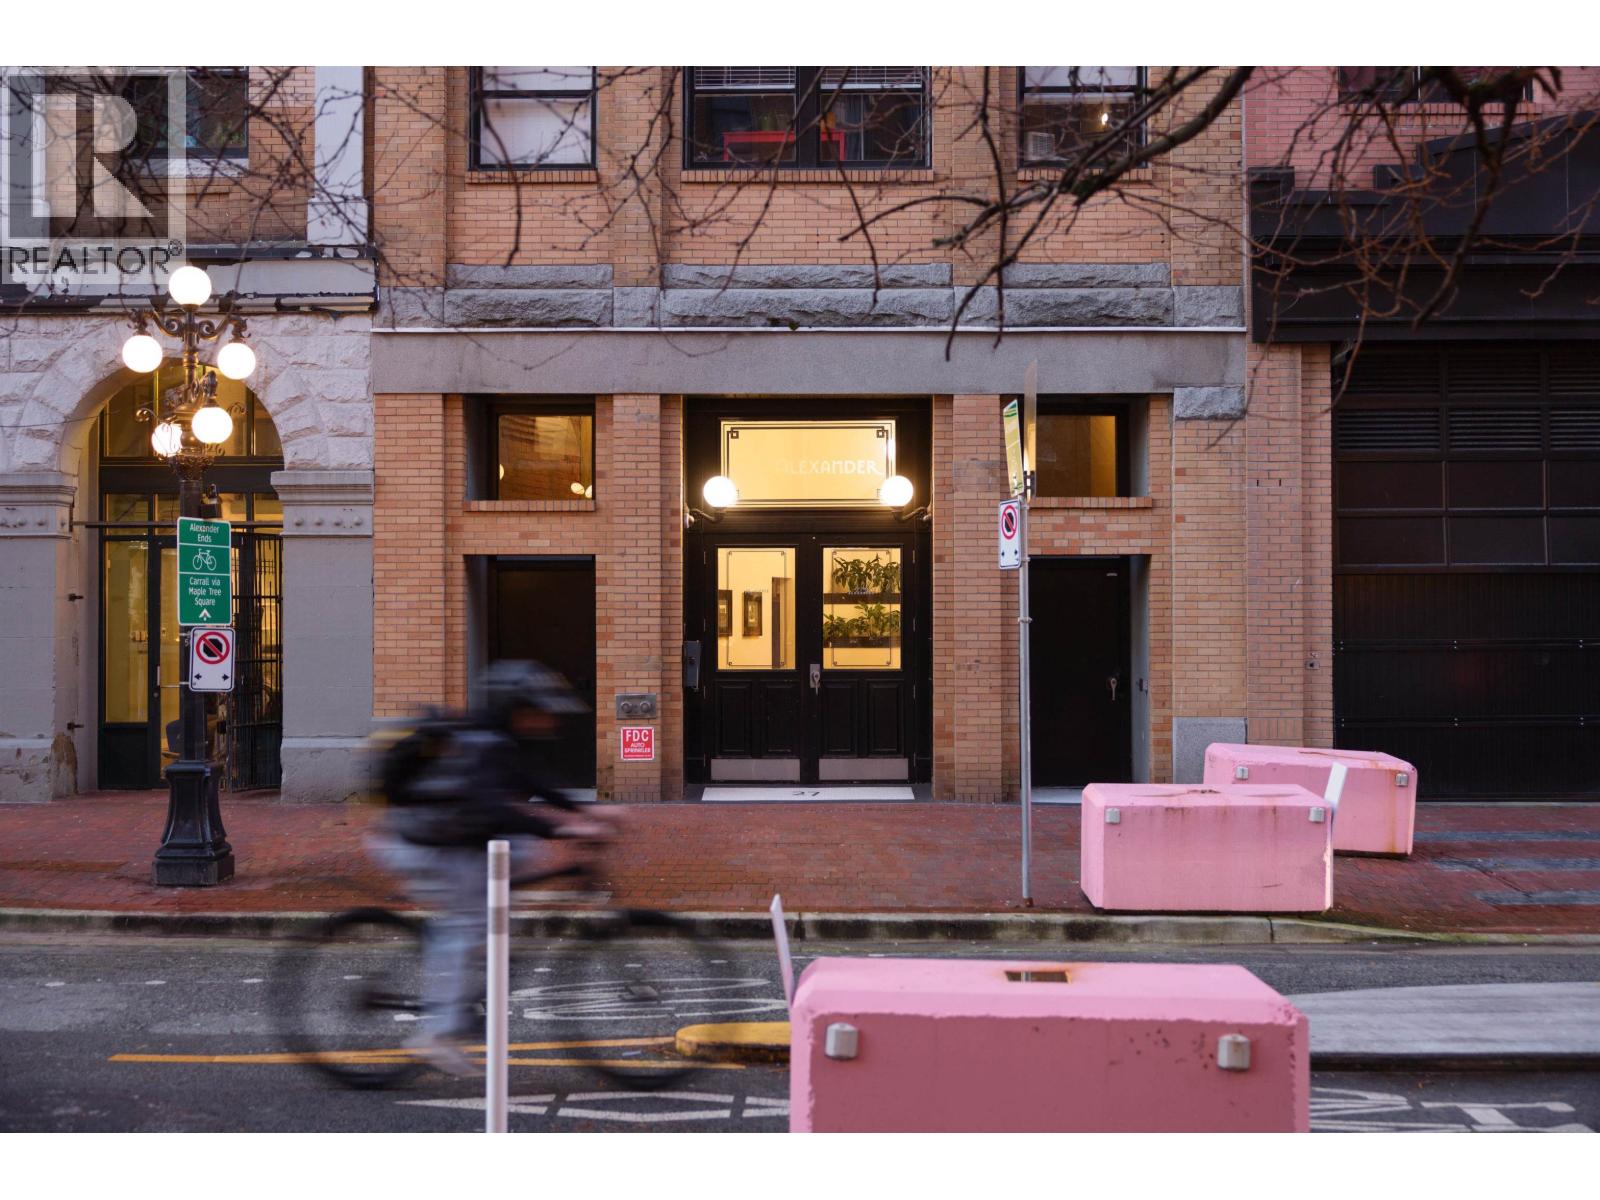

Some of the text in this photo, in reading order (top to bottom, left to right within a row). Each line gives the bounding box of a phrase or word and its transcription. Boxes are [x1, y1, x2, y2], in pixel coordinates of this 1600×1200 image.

[189, 522, 220, 534] Alexander
[197, 533, 212, 543] Ends
[189, 576, 221, 586] Carrall via
[188, 587, 222, 597] Maple Tree
[194, 597, 216, 608] Square
[625, 729, 649, 742] FDC
